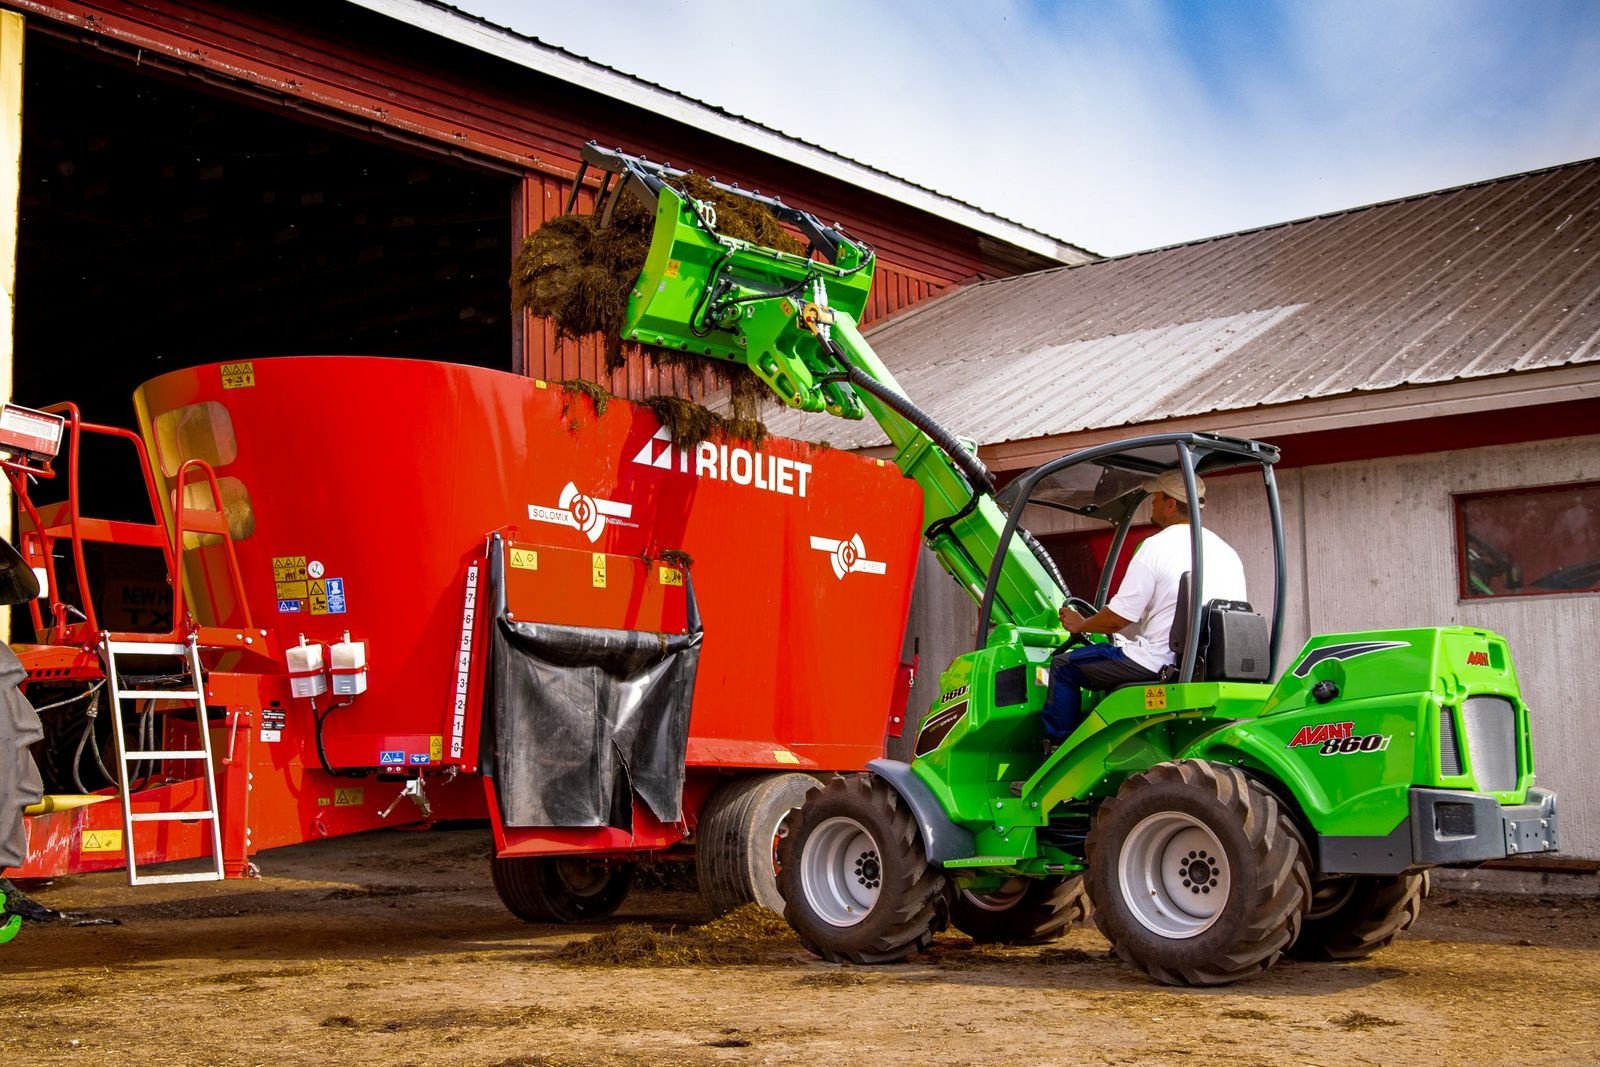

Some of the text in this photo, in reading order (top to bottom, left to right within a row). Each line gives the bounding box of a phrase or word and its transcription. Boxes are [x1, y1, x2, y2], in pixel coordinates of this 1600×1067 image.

[533, 508, 569, 522] SOLOMIX
[469, 572, 475, 581] 8
[468, 593, 473, 602] 7
[465, 614, 471, 624] 6
[463, 635, 469, 645] 5
[461, 657, 467, 666] 4
[1466, 650, 1489, 667] AVANT
[459, 678, 465, 688] 3
[457, 700, 463, 709] 2
[1288, 721, 1354, 748] AVANT
[1319, 734, 1392, 756] 860i
